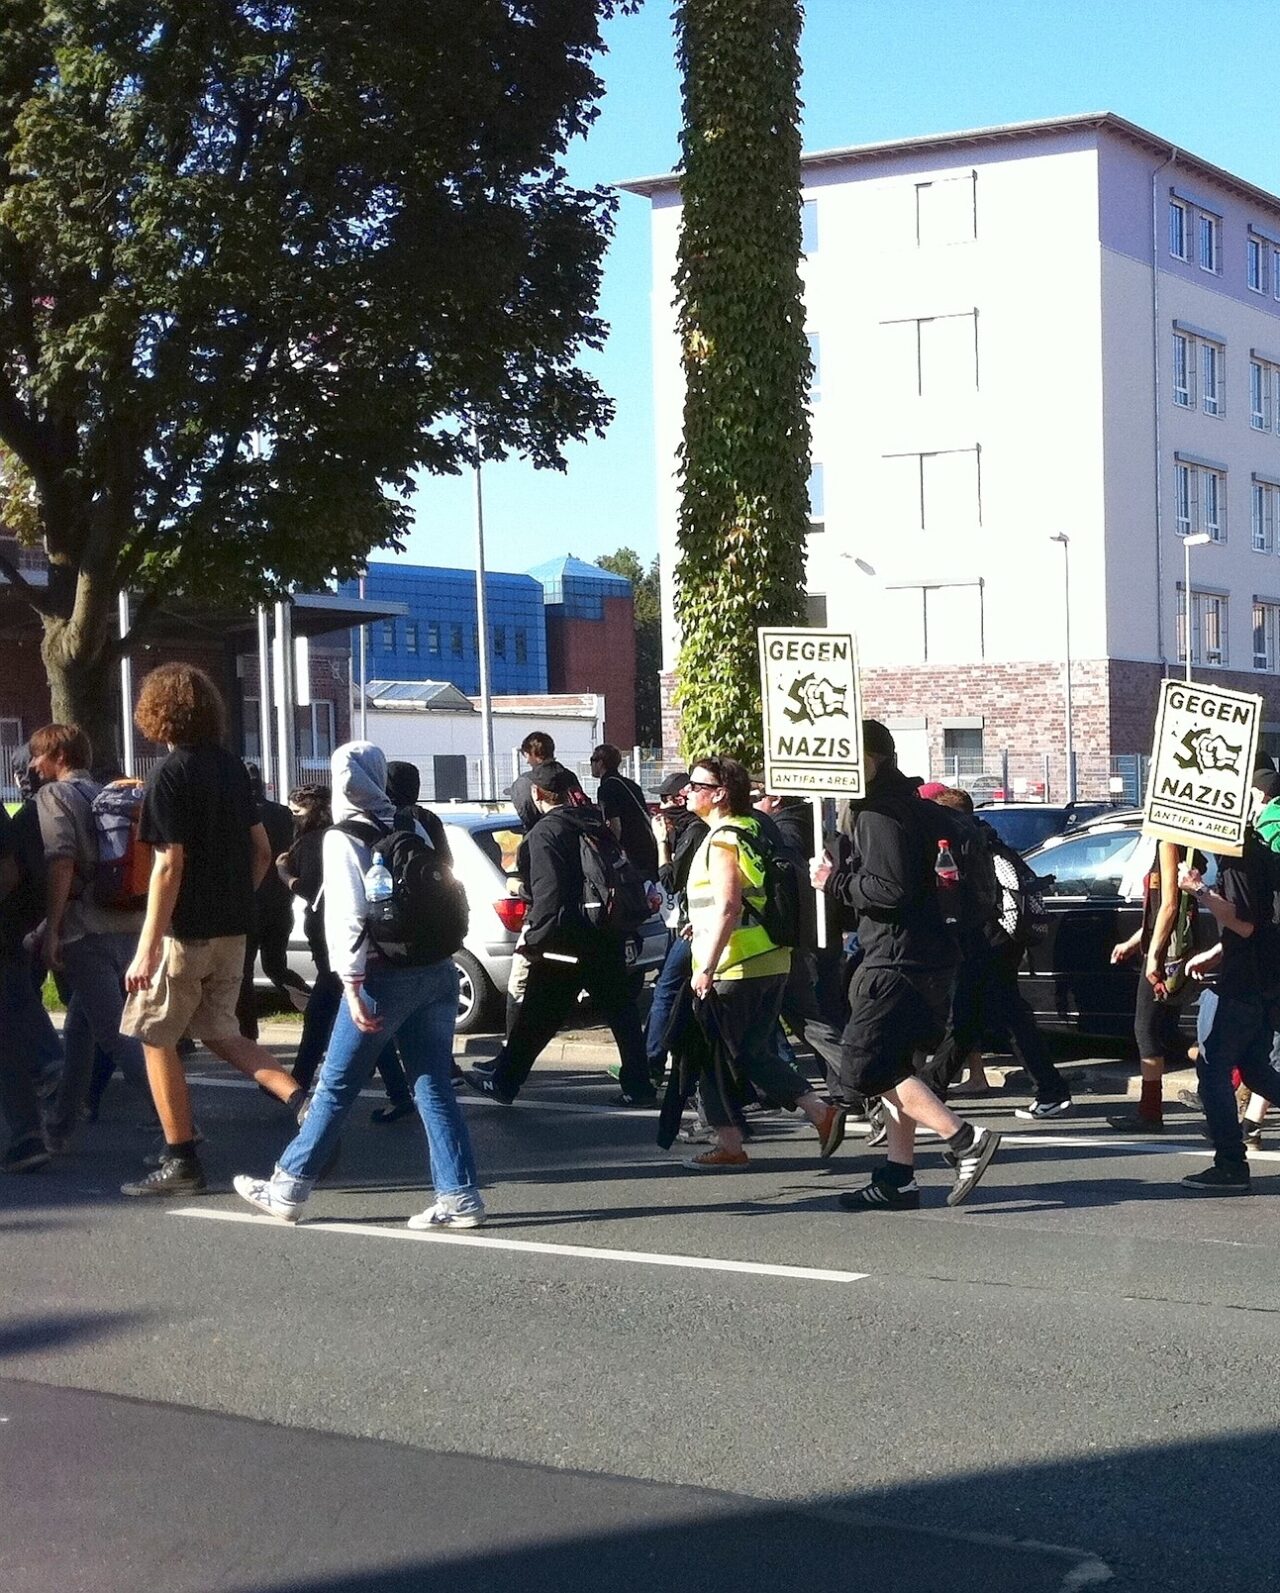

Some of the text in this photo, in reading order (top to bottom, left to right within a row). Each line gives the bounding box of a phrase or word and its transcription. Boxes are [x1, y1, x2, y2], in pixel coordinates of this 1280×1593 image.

[769, 640, 848, 662] GEGEN
[1169, 691, 1250, 726] GEGEN
[778, 736, 851, 758] NAZIS
[775, 773, 857, 786] ANTIFA AREA
[1161, 777, 1238, 810] NAZIS
[1154, 810, 1237, 836] ANTIFA AREA
